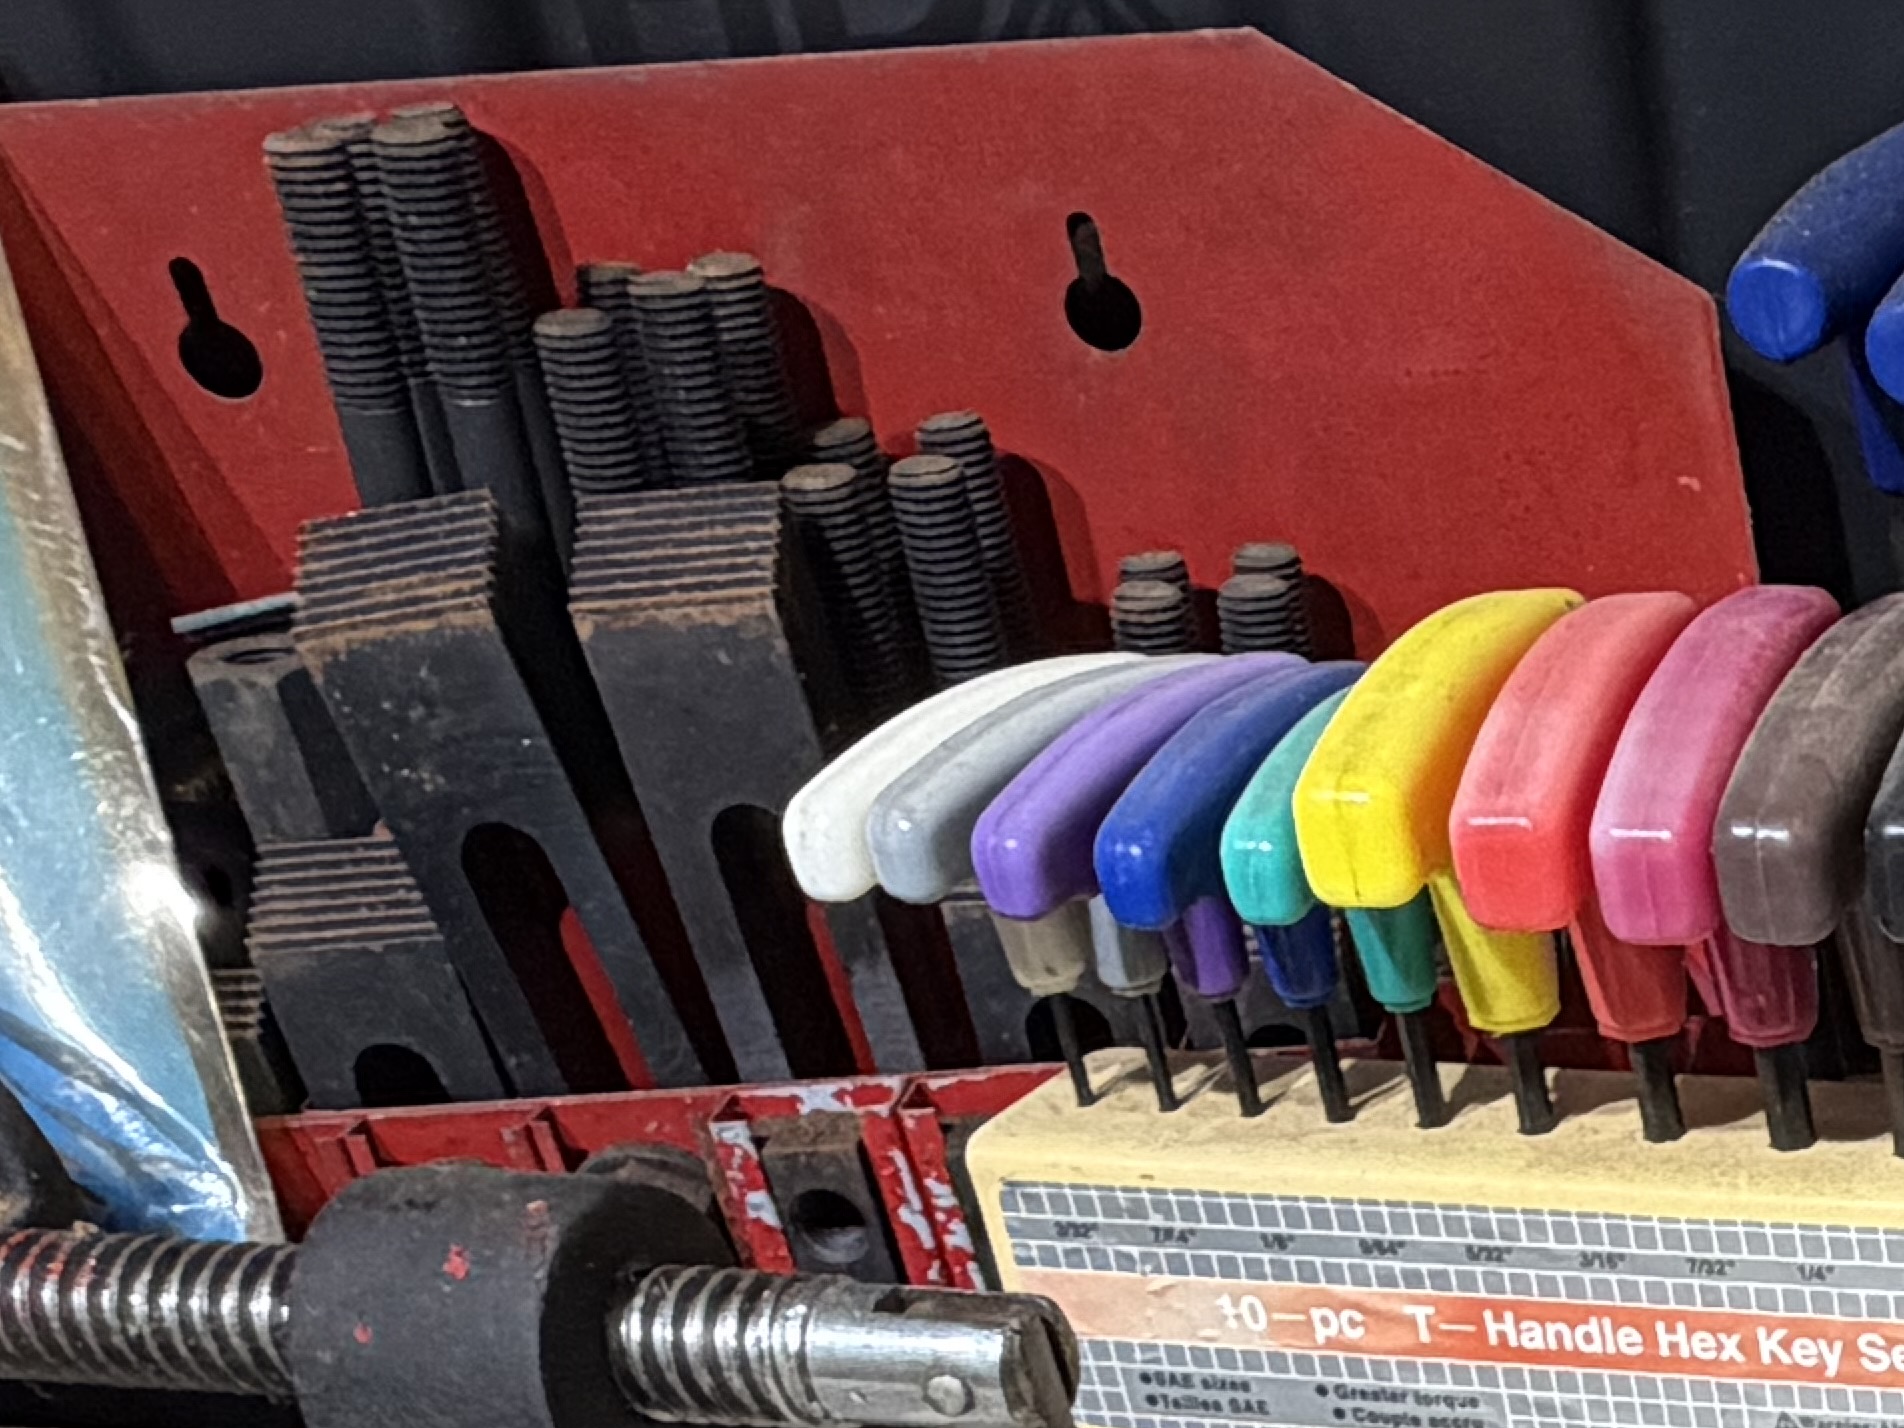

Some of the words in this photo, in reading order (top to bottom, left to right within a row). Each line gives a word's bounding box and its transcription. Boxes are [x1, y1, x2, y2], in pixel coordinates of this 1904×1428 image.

[1656, 1319, 1746, 1364] Hex
[1757, 1326, 1846, 1378] Key
[1333, 1383, 1408, 1405] Greater
[1412, 1391, 1480, 1411] torque
